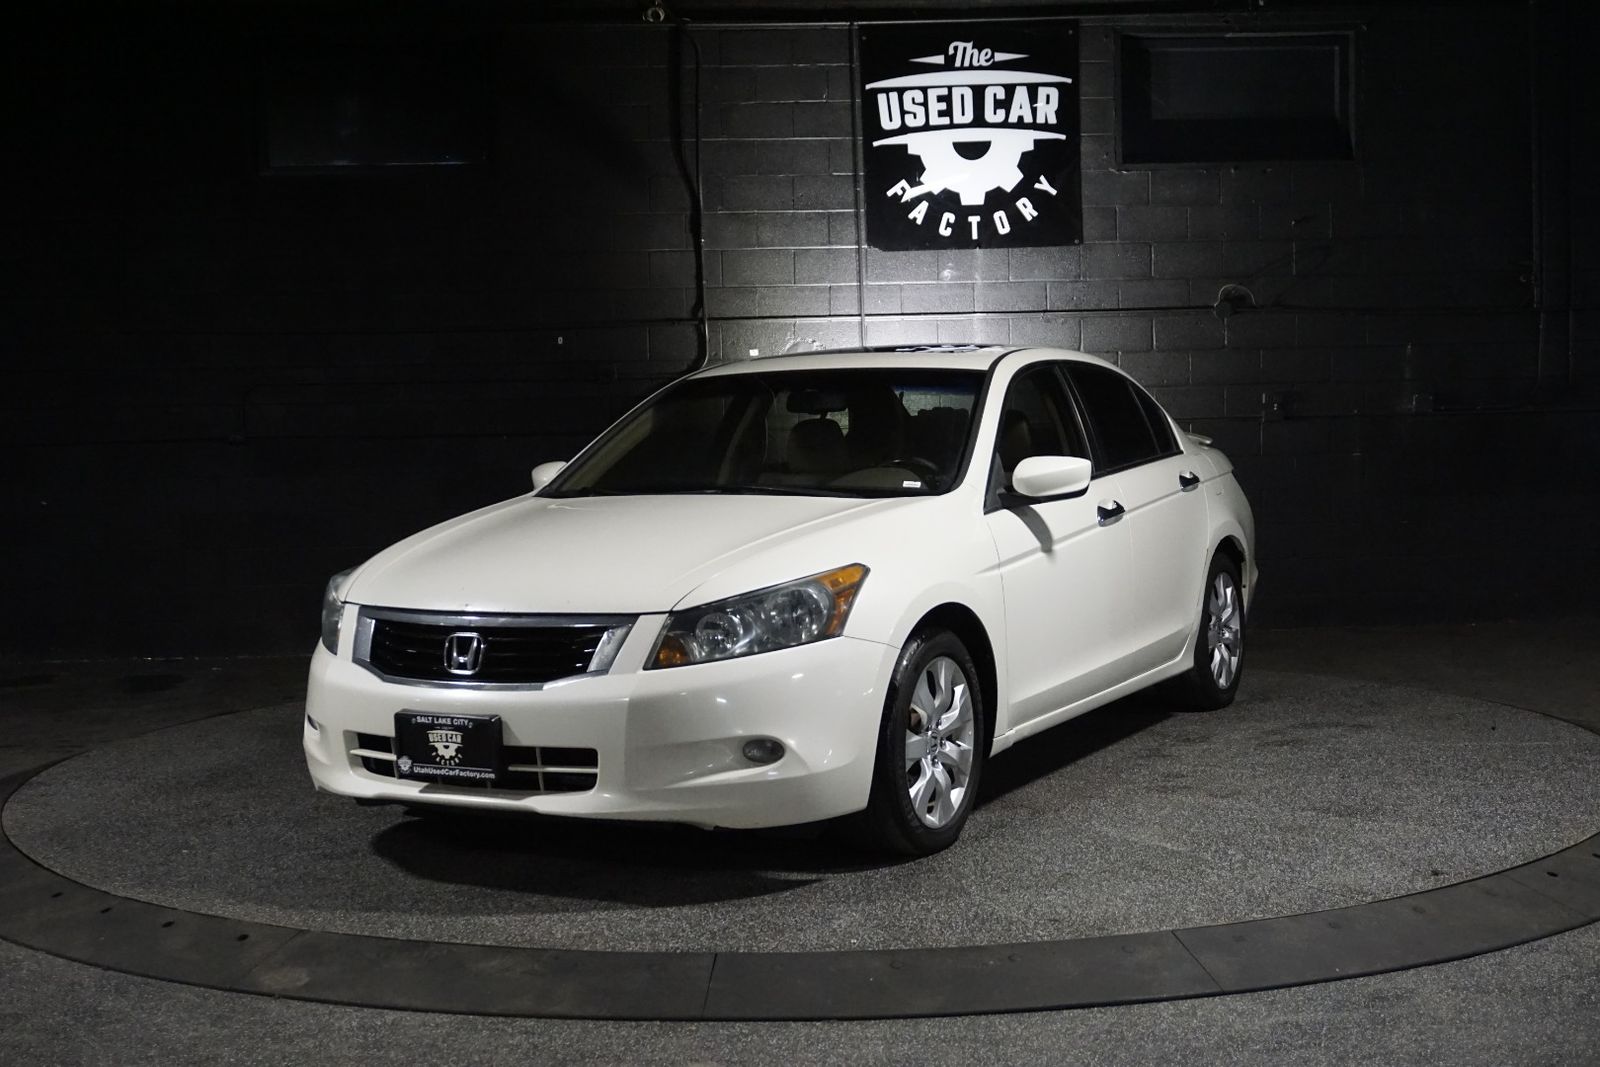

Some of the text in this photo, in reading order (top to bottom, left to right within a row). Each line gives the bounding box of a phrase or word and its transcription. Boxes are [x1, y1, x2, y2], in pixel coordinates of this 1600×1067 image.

[949, 41, 993, 67] The
[877, 85, 1059, 130] USED CAR
[886, 174, 1057, 240] FACTORY
[416, 715, 469, 726] SALT LAKE CITY
